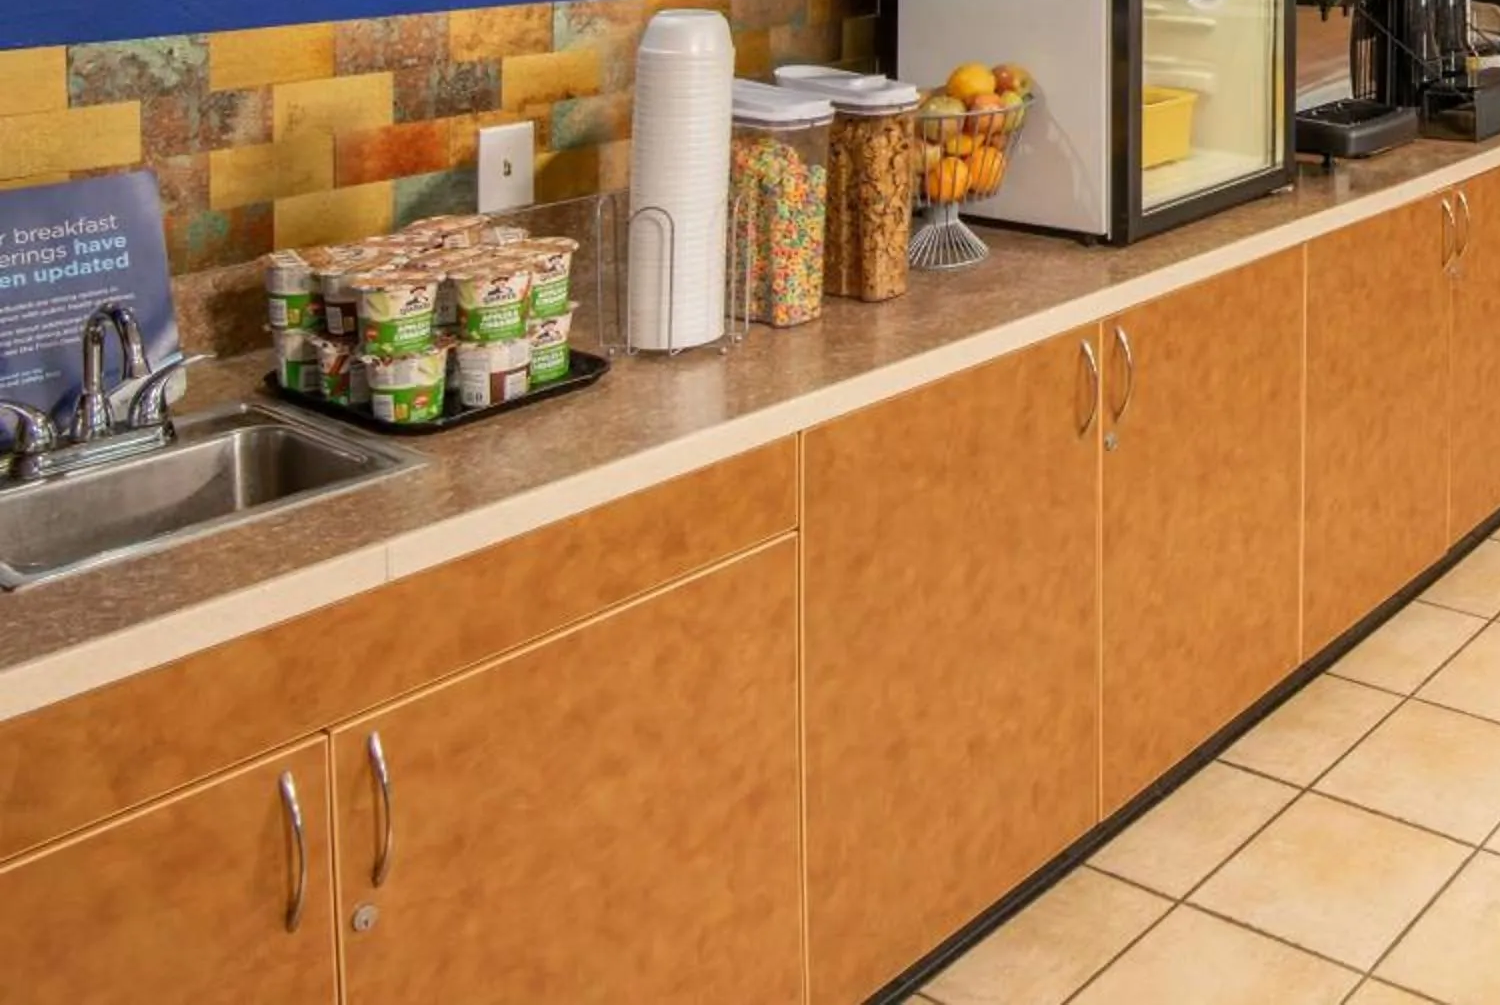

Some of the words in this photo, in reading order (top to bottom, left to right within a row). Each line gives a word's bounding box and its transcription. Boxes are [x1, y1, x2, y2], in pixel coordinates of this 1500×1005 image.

[13, 214, 119, 244] breakfast
[73, 236, 127, 255] have
[33, 250, 129, 283] updated
